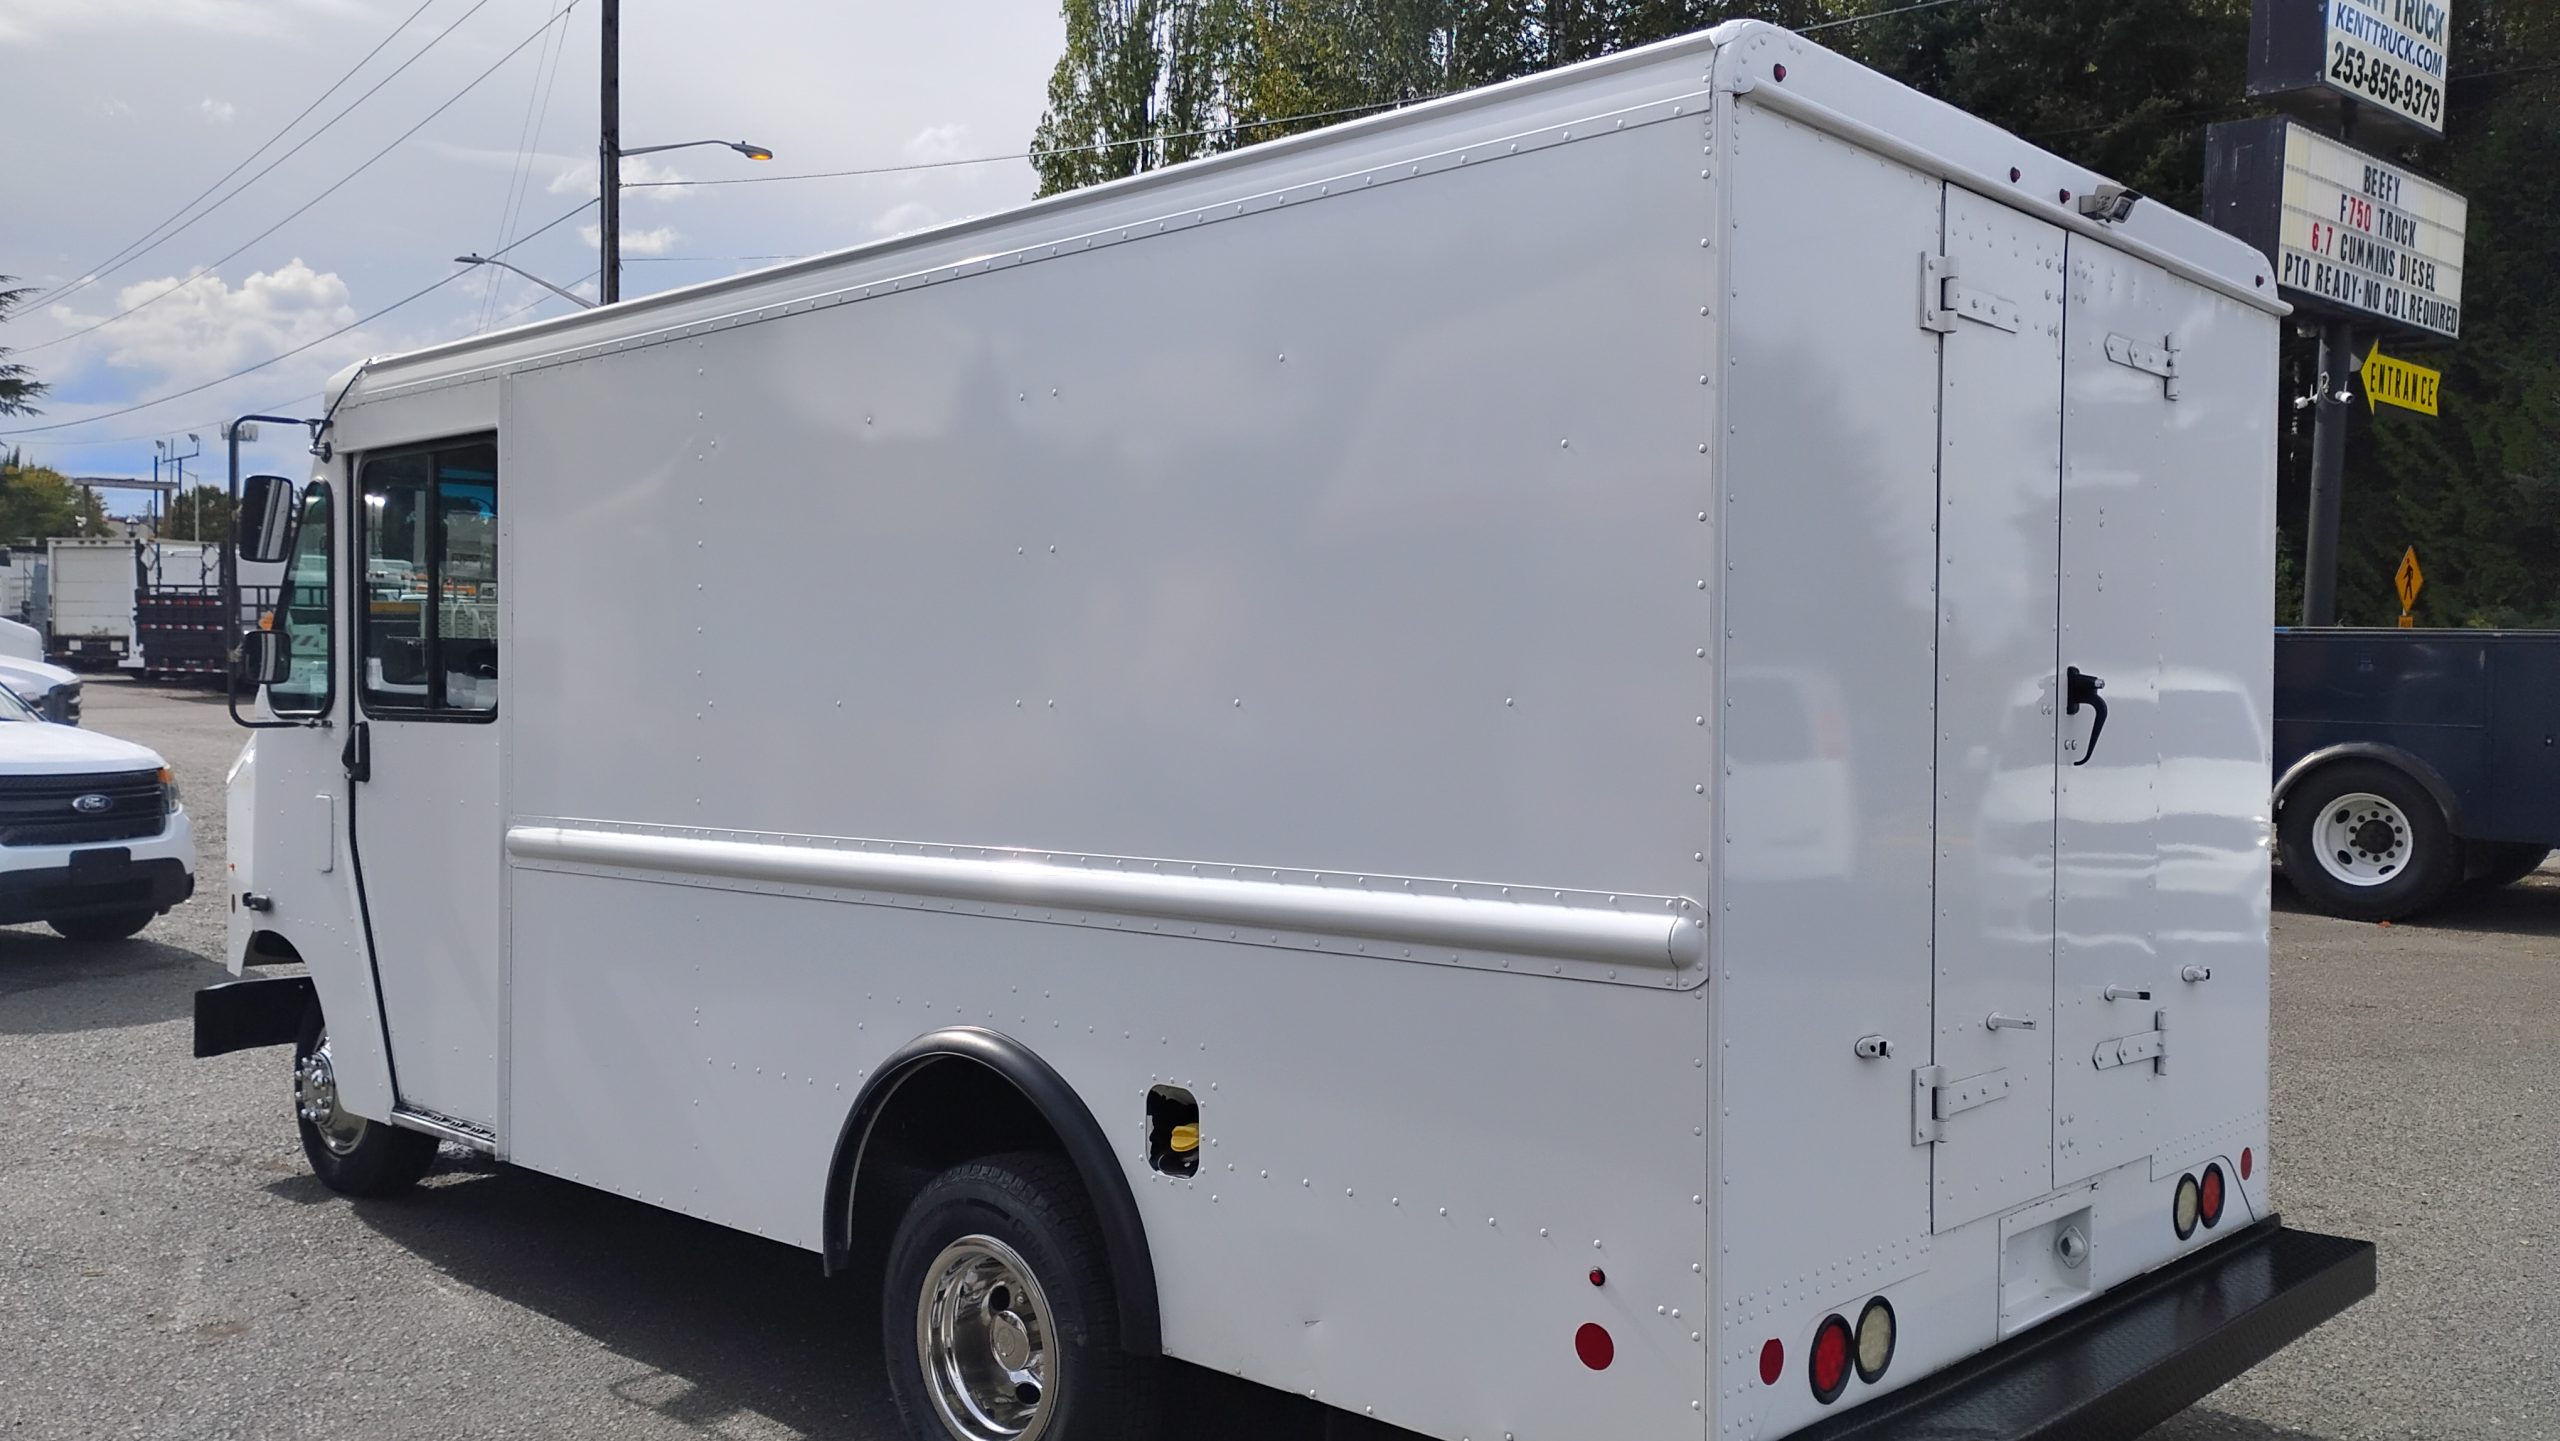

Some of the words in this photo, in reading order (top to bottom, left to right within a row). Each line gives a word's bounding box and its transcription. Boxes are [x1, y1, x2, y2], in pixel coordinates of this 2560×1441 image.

[2335, 2, 2442, 77] KENTTRUCK.COM
[2331, 41, 2440, 123] 253-856-9379
[2364, 165, 2400, 204] BEEFY
[2312, 222, 2333, 256] 6.7
[2340, 233, 2395, 277] CUMMINS
[2400, 253, 2435, 292] DIESEL
[2379, 208, 2416, 248] TRUCK
[2284, 253, 2310, 288] PTO
[2408, 294, 2458, 334] REQUIRED
[2370, 362, 2434, 407] ENTRANCE
